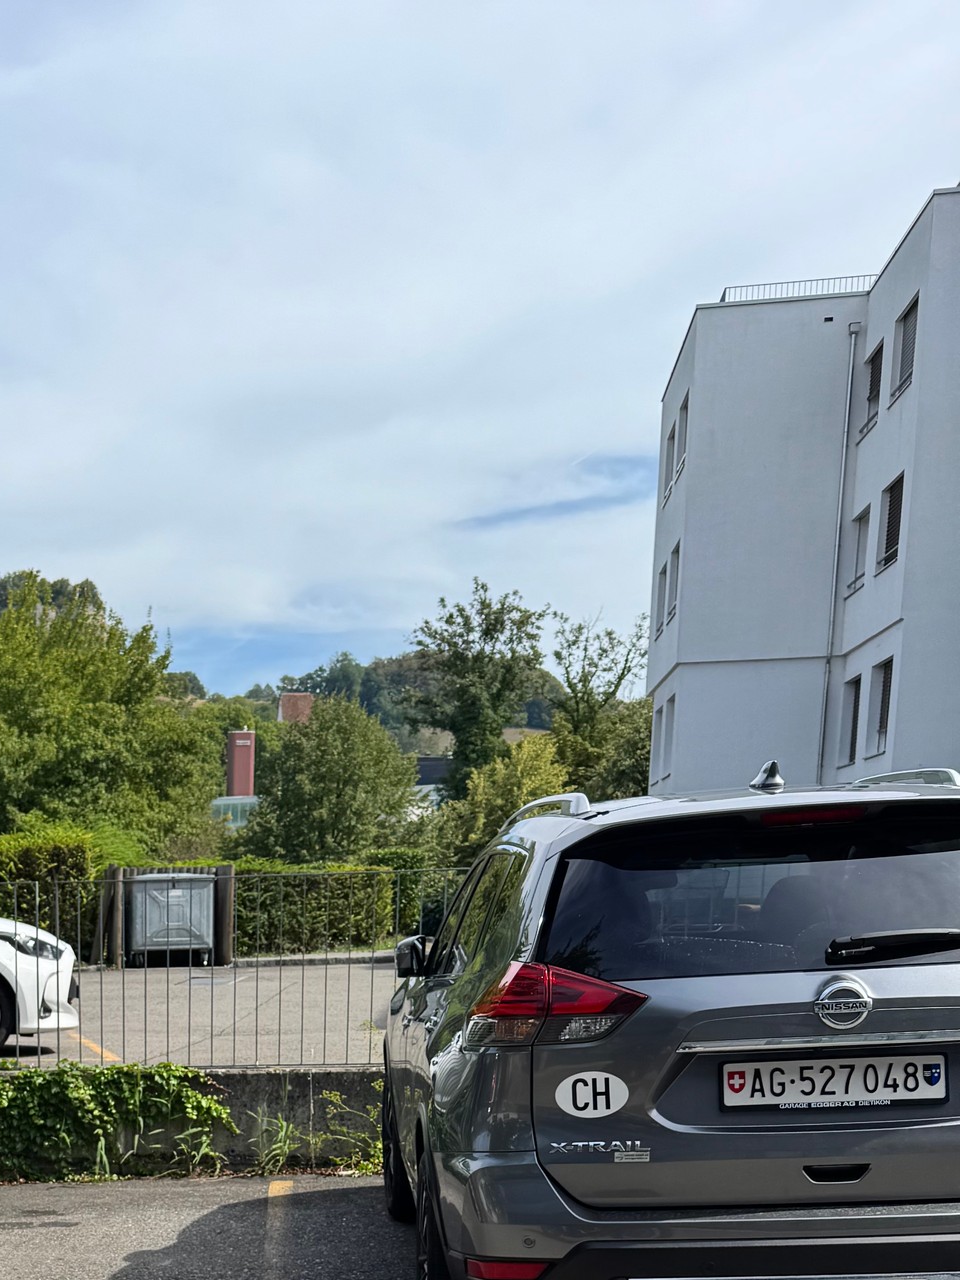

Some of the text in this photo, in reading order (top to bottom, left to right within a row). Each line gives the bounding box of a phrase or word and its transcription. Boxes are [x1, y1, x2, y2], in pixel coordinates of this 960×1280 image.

[821, 1002, 867, 1011] NISSAN
[571, 1077, 611, 1111] CH
[549, 1141, 651, 1154] X-TRAIL
